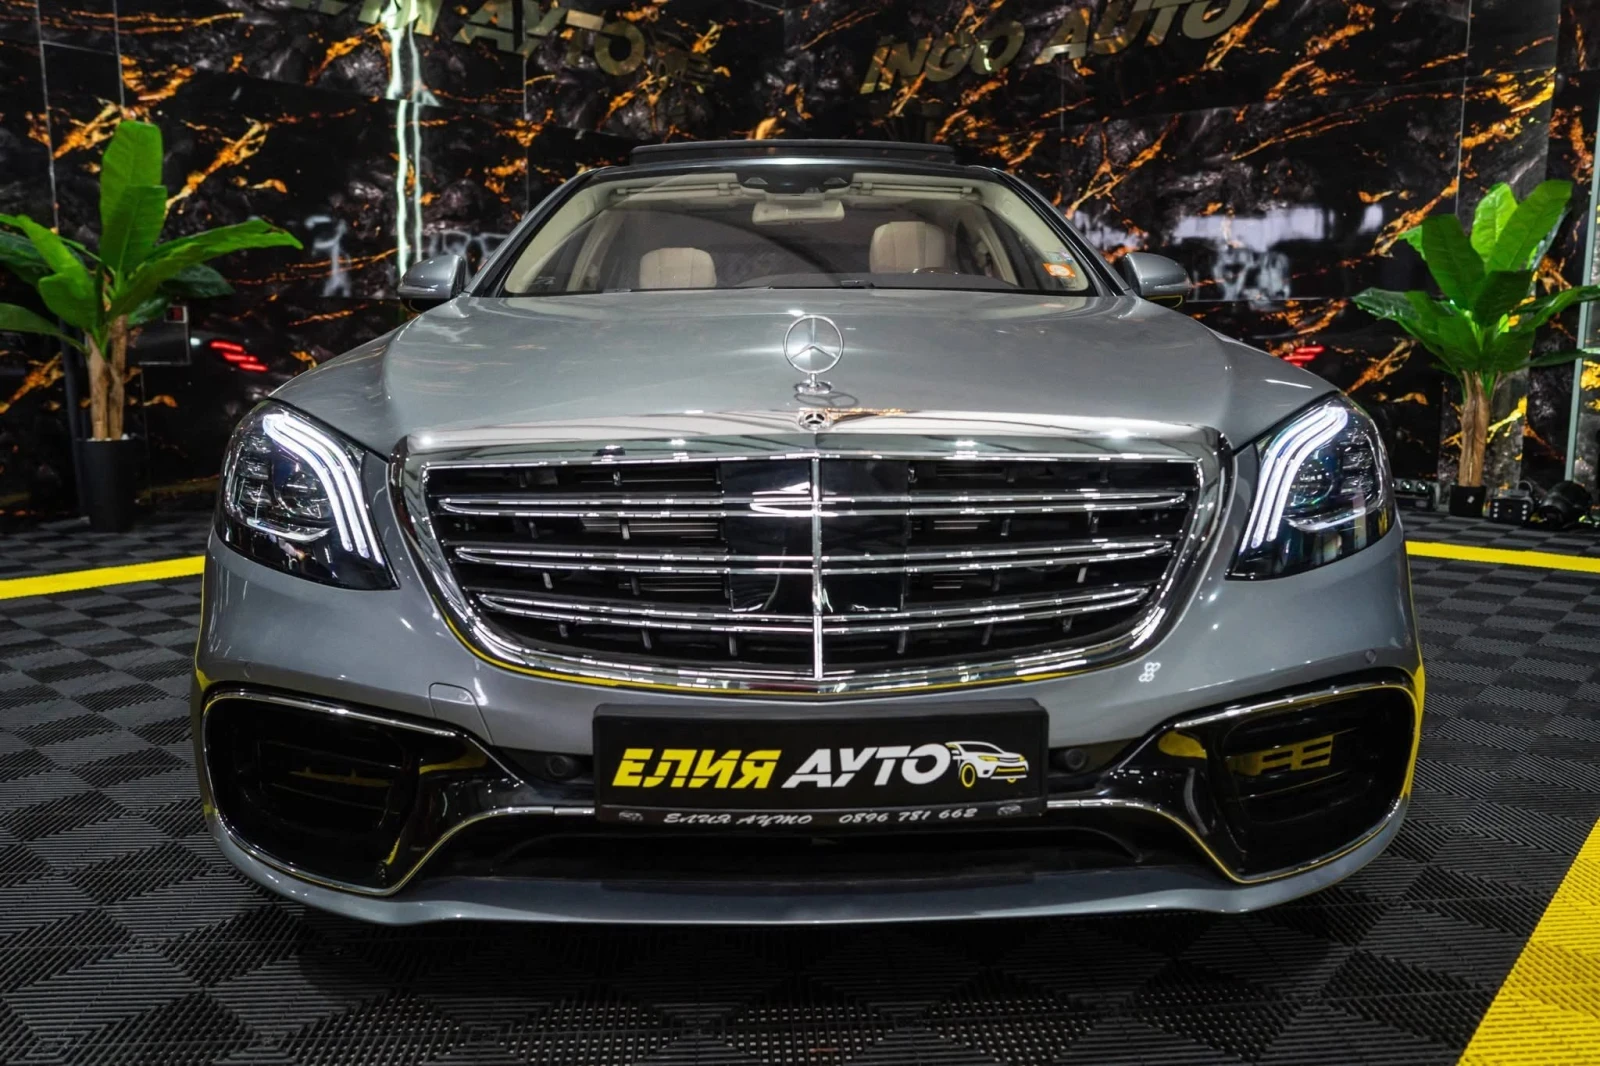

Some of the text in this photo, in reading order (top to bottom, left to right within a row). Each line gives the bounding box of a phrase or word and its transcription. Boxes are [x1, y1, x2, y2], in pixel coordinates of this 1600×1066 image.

[859, 0, 1250, 94] INGO AUTO
[612, 743, 951, 788] ЕЛИЯ АУТО
[838, 812, 890, 824] 0896
[898, 810, 932, 822] 781
